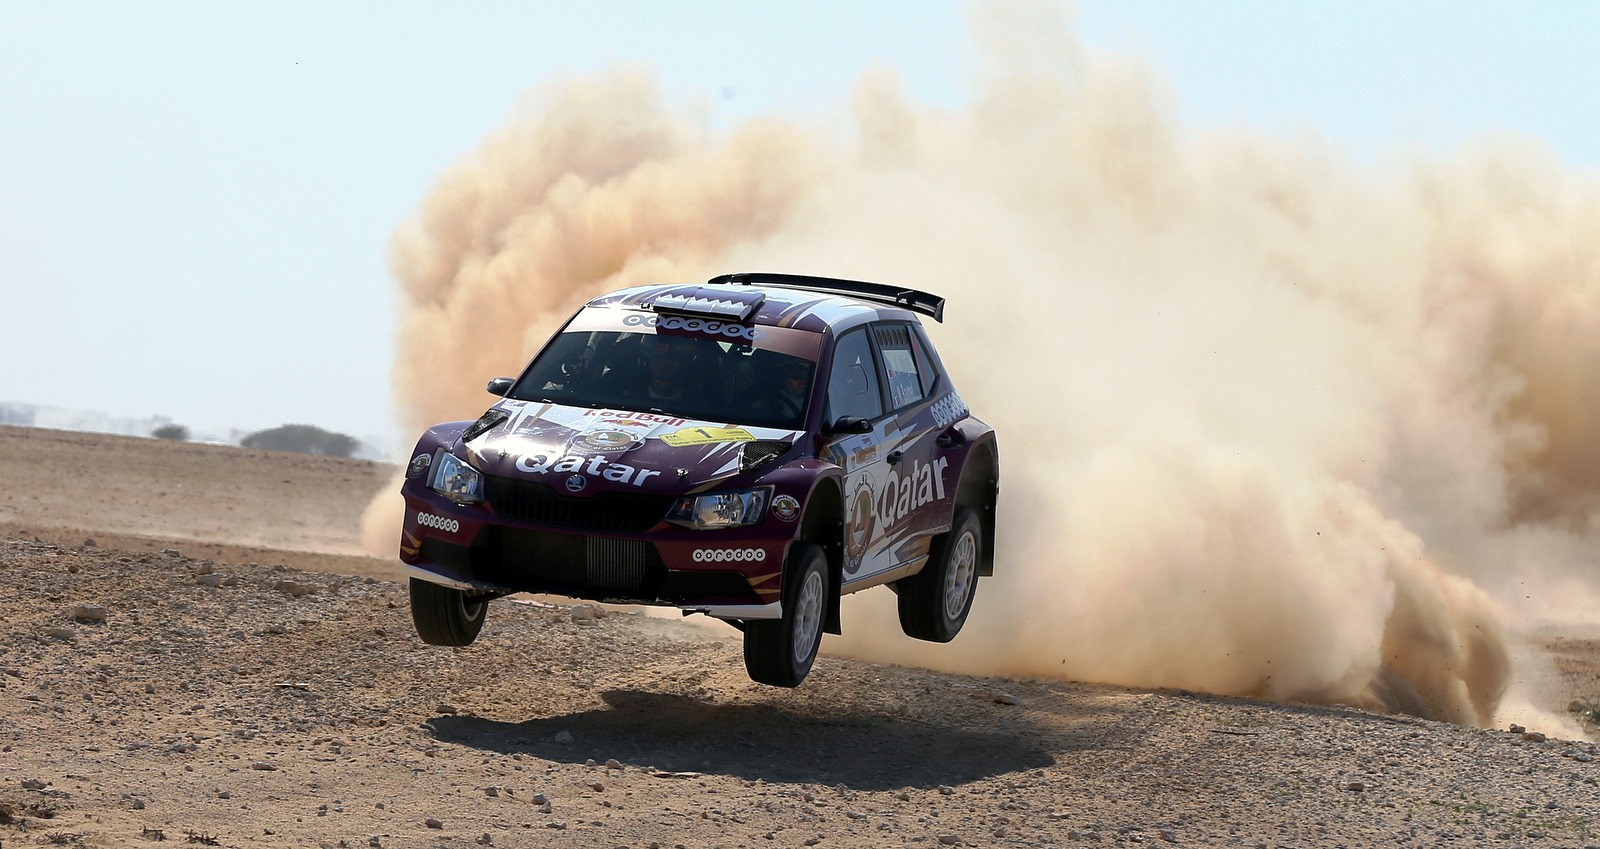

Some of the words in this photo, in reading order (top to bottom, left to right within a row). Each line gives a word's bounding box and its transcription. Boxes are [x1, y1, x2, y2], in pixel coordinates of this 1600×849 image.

[622, 313, 767, 341] ooredoo
[694, 428, 713, 439] 1
[515, 452, 661, 487] Qatar
[881, 456, 948, 528] Qatar
[417, 511, 459, 533] ooredoo
[692, 548, 766, 562] ooredoo
